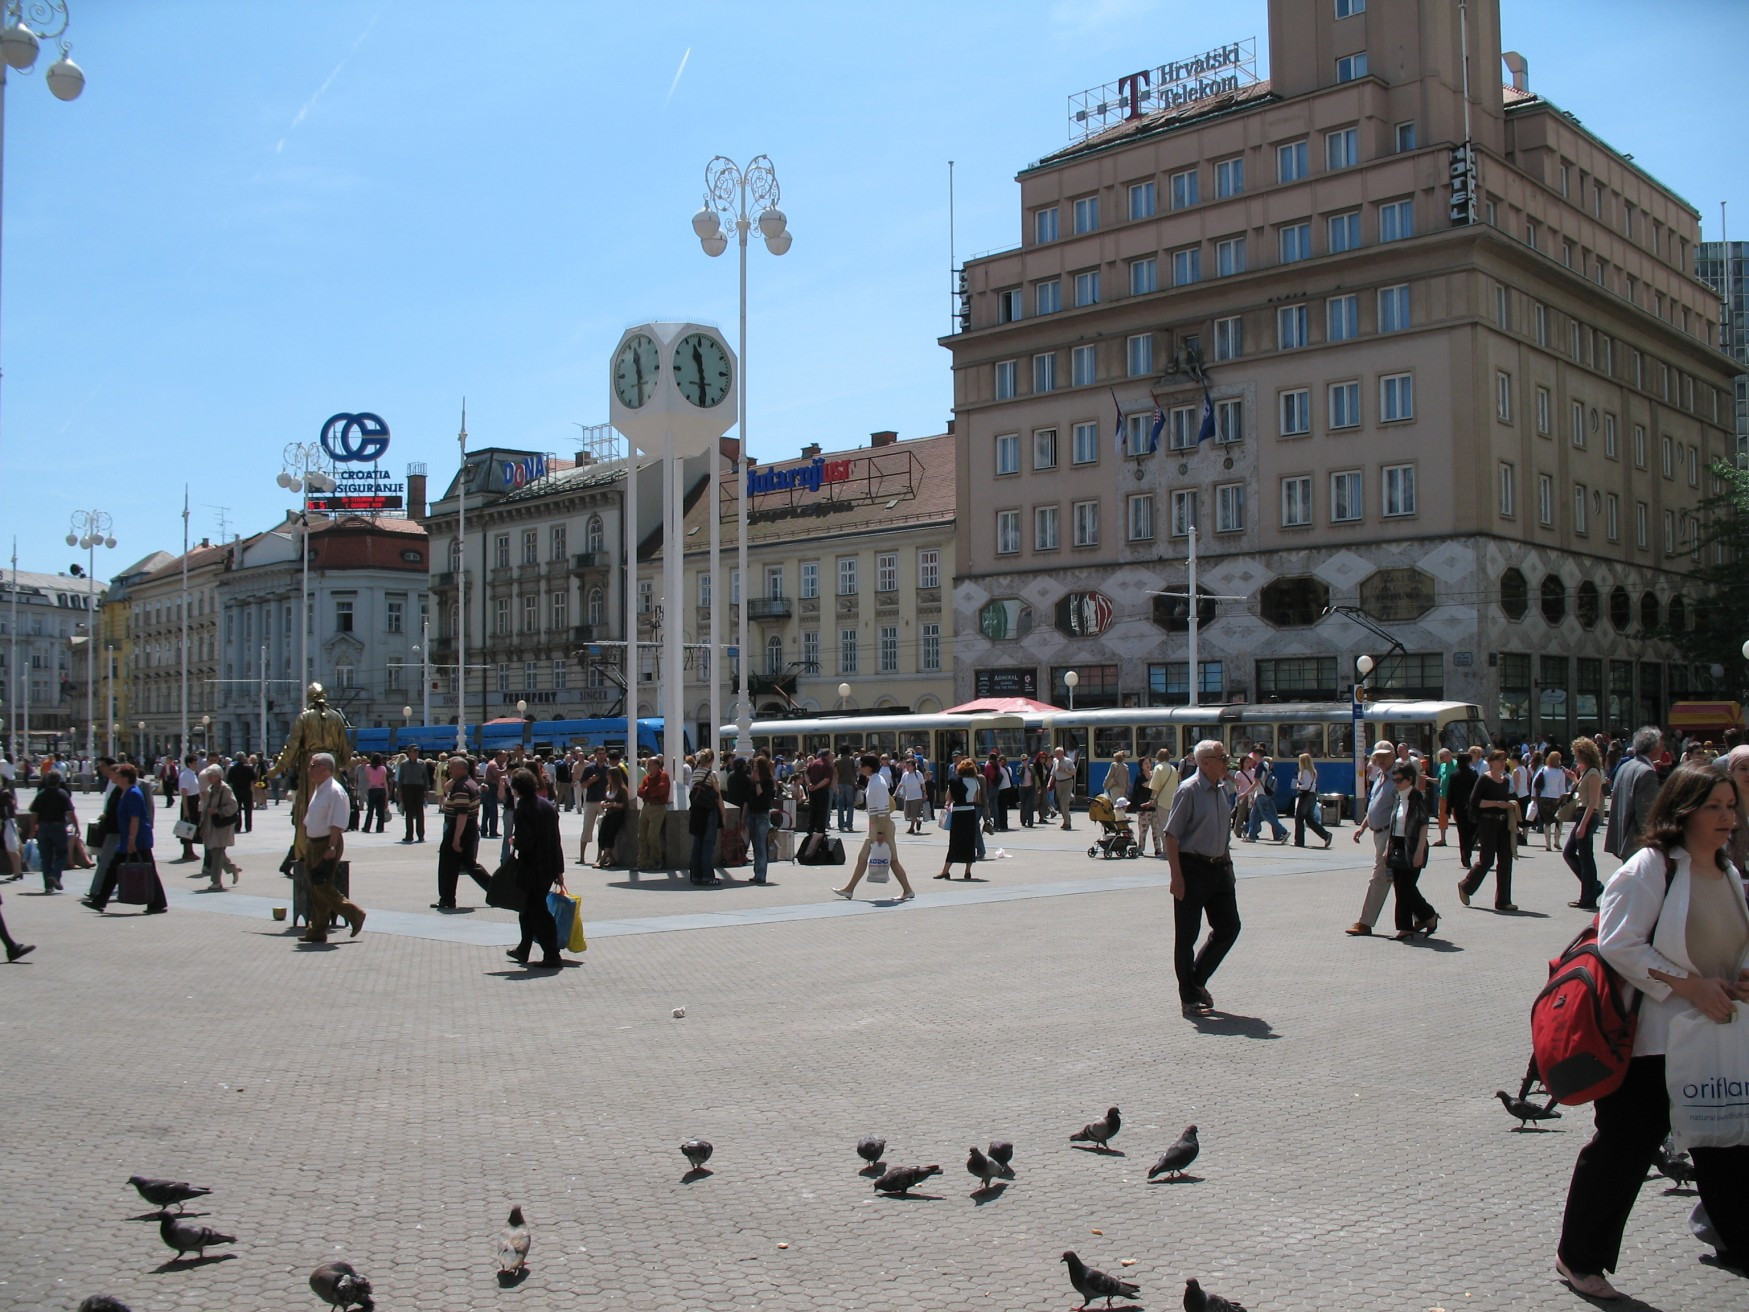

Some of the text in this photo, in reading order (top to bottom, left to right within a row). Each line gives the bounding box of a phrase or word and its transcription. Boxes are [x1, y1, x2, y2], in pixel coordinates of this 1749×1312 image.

[1160, 42, 1240, 86] Hrvatski
[1118, 70, 1150, 121] T
[1160, 75, 1238, 110] Telekom
[1449, 147, 1467, 220] HOTEL
[335, 483, 404, 493] SIGURANJE
[340, 470, 391, 480] CROATIA
[503, 454, 546, 488] DONA
[579, 690, 608, 702] SINGER
[1689, 1113, 1716, 1121] natural
